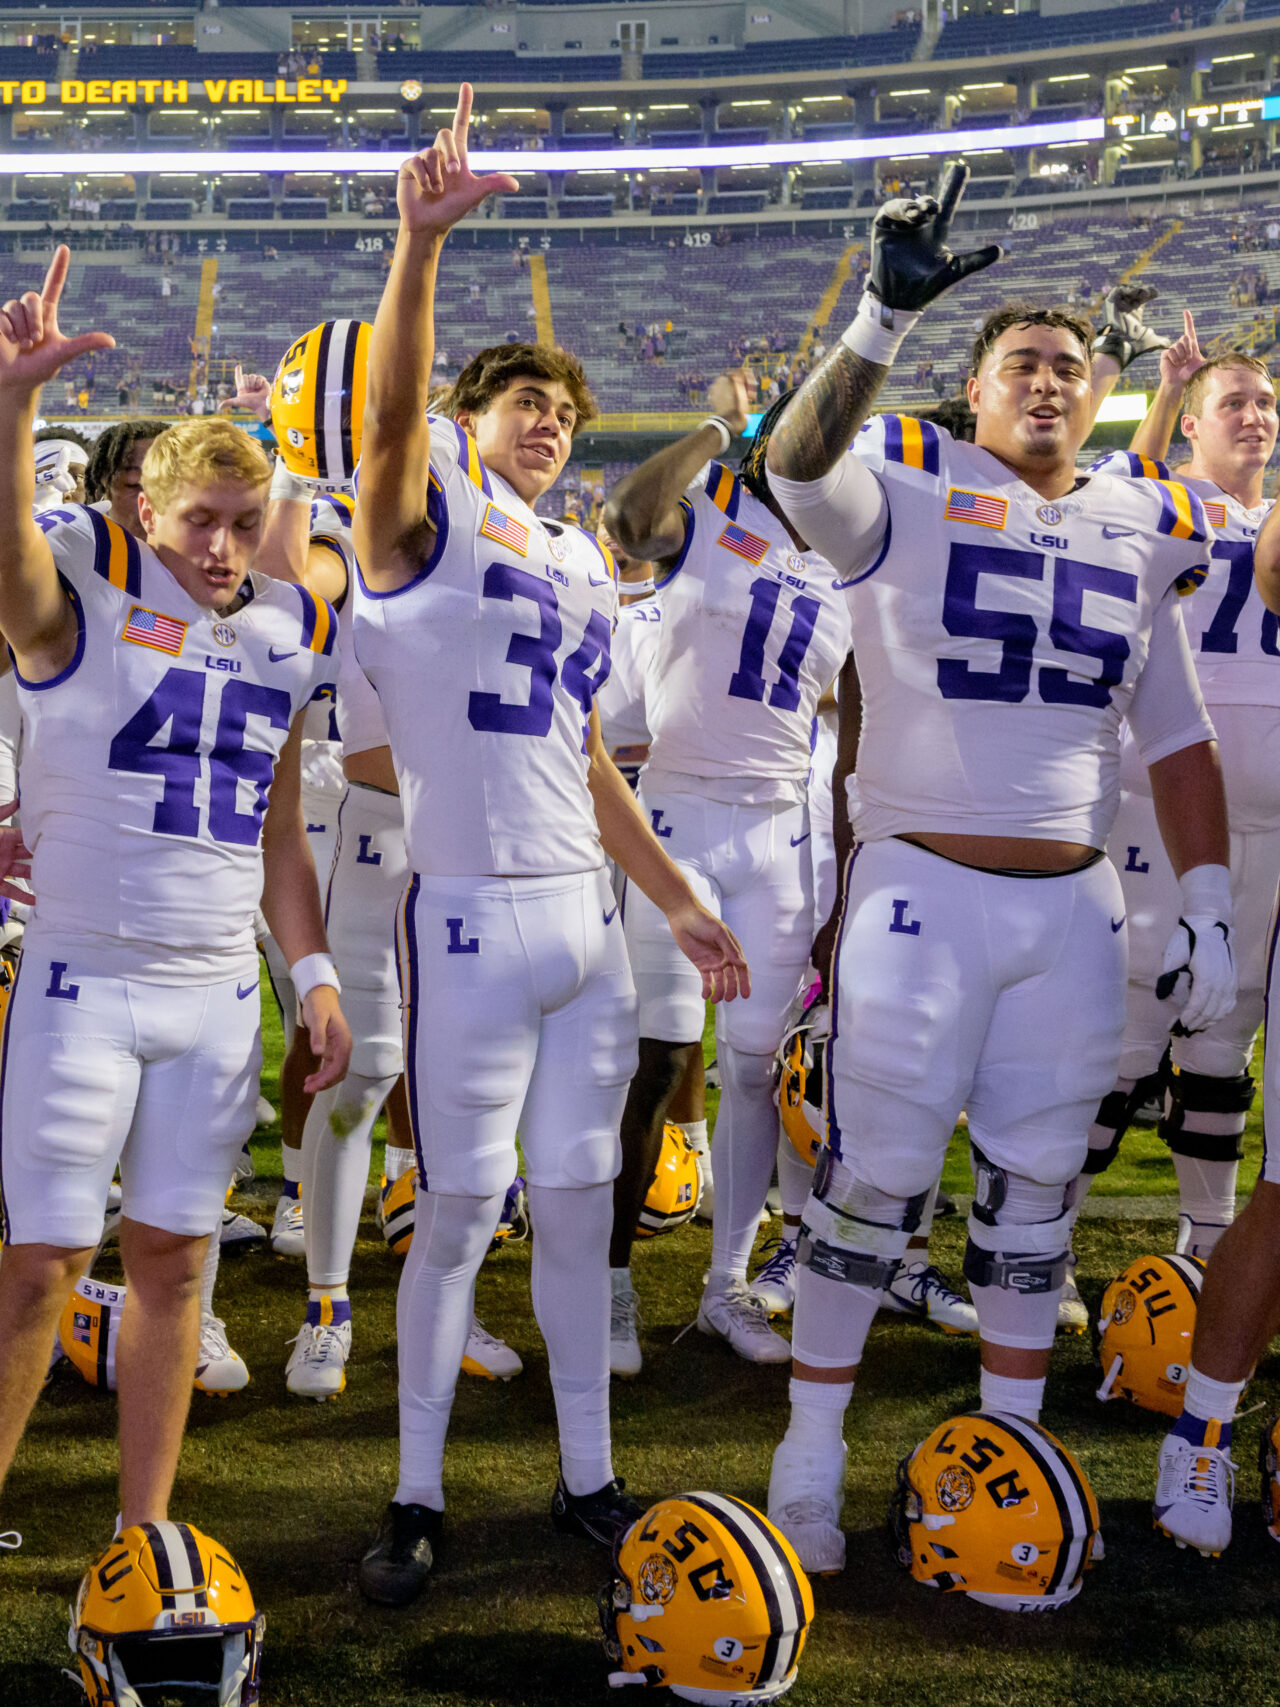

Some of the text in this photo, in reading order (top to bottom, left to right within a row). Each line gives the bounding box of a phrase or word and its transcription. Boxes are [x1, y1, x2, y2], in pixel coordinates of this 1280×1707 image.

[61, 80, 188, 103] DEATH
[204, 79, 348, 102] VALLEY
[355, 238, 384, 252] 418
[683, 233, 711, 247] 419
[1030, 532, 1069, 550] LSU
[545, 565, 569, 588] LSU
[777, 571, 807, 590] LSU
[936, 543, 1138, 708] 55
[728, 577, 821, 711] 11
[205, 655, 241, 673] LSU
[468, 562, 612, 756] 34
[109, 668, 291, 846] 46
[651, 810, 672, 837] L
[357, 836, 381, 864] L
[1125, 846, 1149, 873] L
[889, 900, 921, 936] L
[445, 918, 480, 954] L
[46, 962, 79, 1000] L
[1172, 1367, 1182, 1380] 3
[935, 1427, 1030, 1508] LSU
[639, 1512, 735, 1602] LSU
[1019, 1546, 1031, 1561] 3
[1039, 1576, 1049, 1587] 5
[170, 1611, 207, 1625] LSU
[721, 1641, 736, 1657] 3
[746, 1672, 756, 1684] 3
